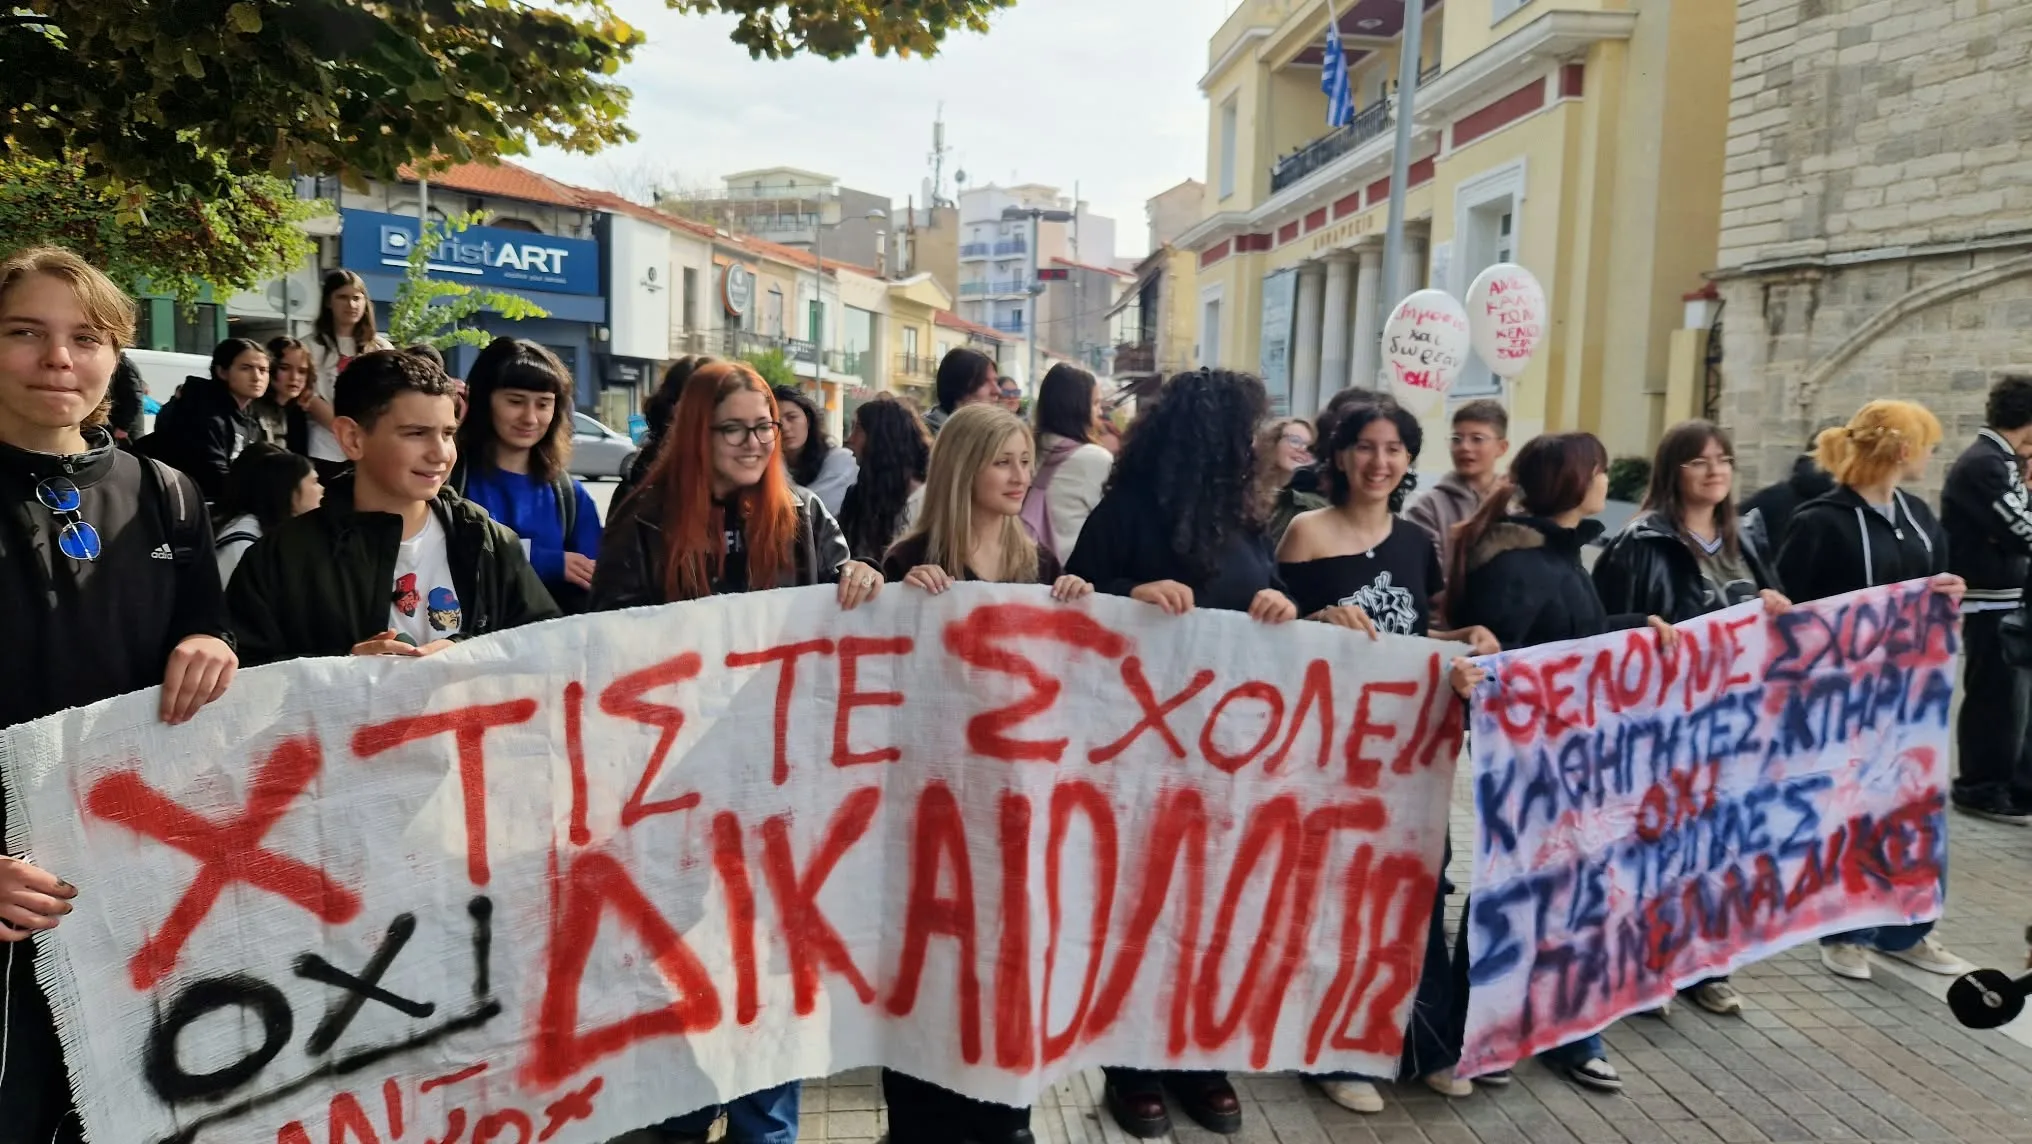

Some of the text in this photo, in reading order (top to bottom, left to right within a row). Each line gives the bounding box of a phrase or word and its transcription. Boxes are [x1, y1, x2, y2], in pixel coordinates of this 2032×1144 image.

[1483, 588, 1958, 745] ΘΕΛΟΥΜΕ ΣΧΟΛΕΙΑ
[84, 602, 1463, 991] ΧΤΙΣΤΕ ΣΧΟΛΕΙΑ
[1636, 758, 1719, 844] ΟΧΙ
[143, 895, 496, 1103] ΟΧΙ
